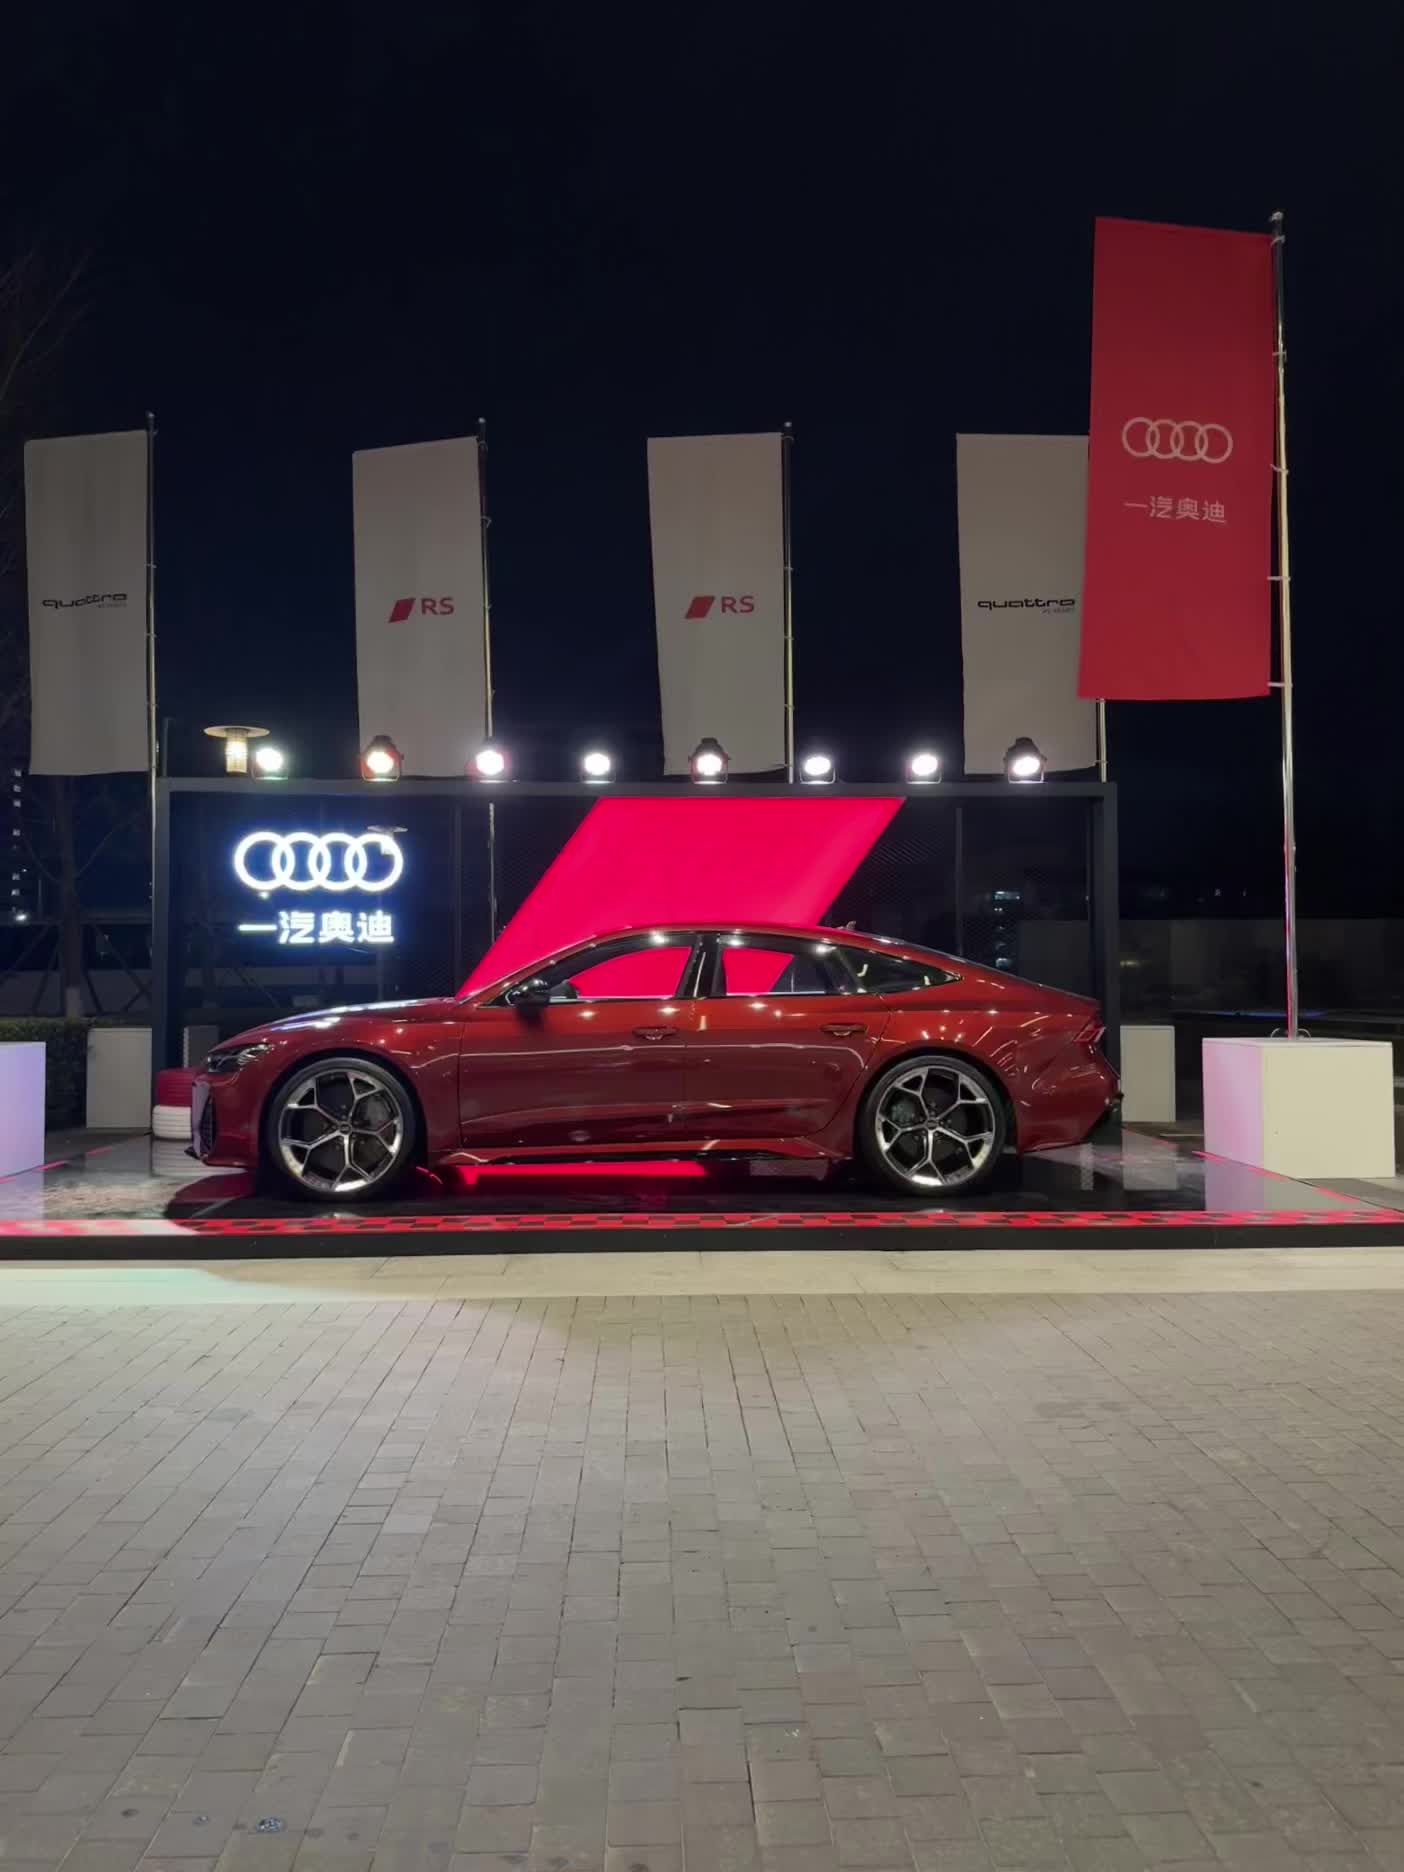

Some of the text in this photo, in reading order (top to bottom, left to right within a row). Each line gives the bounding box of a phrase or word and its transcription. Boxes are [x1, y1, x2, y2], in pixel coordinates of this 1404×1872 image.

[1123, 496, 1226, 523] 一汽奥迪
[42, 593, 127, 609] quattro
[421, 597, 455, 615] RS
[721, 595, 755, 613] RS
[977, 598, 1075, 611] quattro
[238, 910, 394, 944] 一汽奥迪
